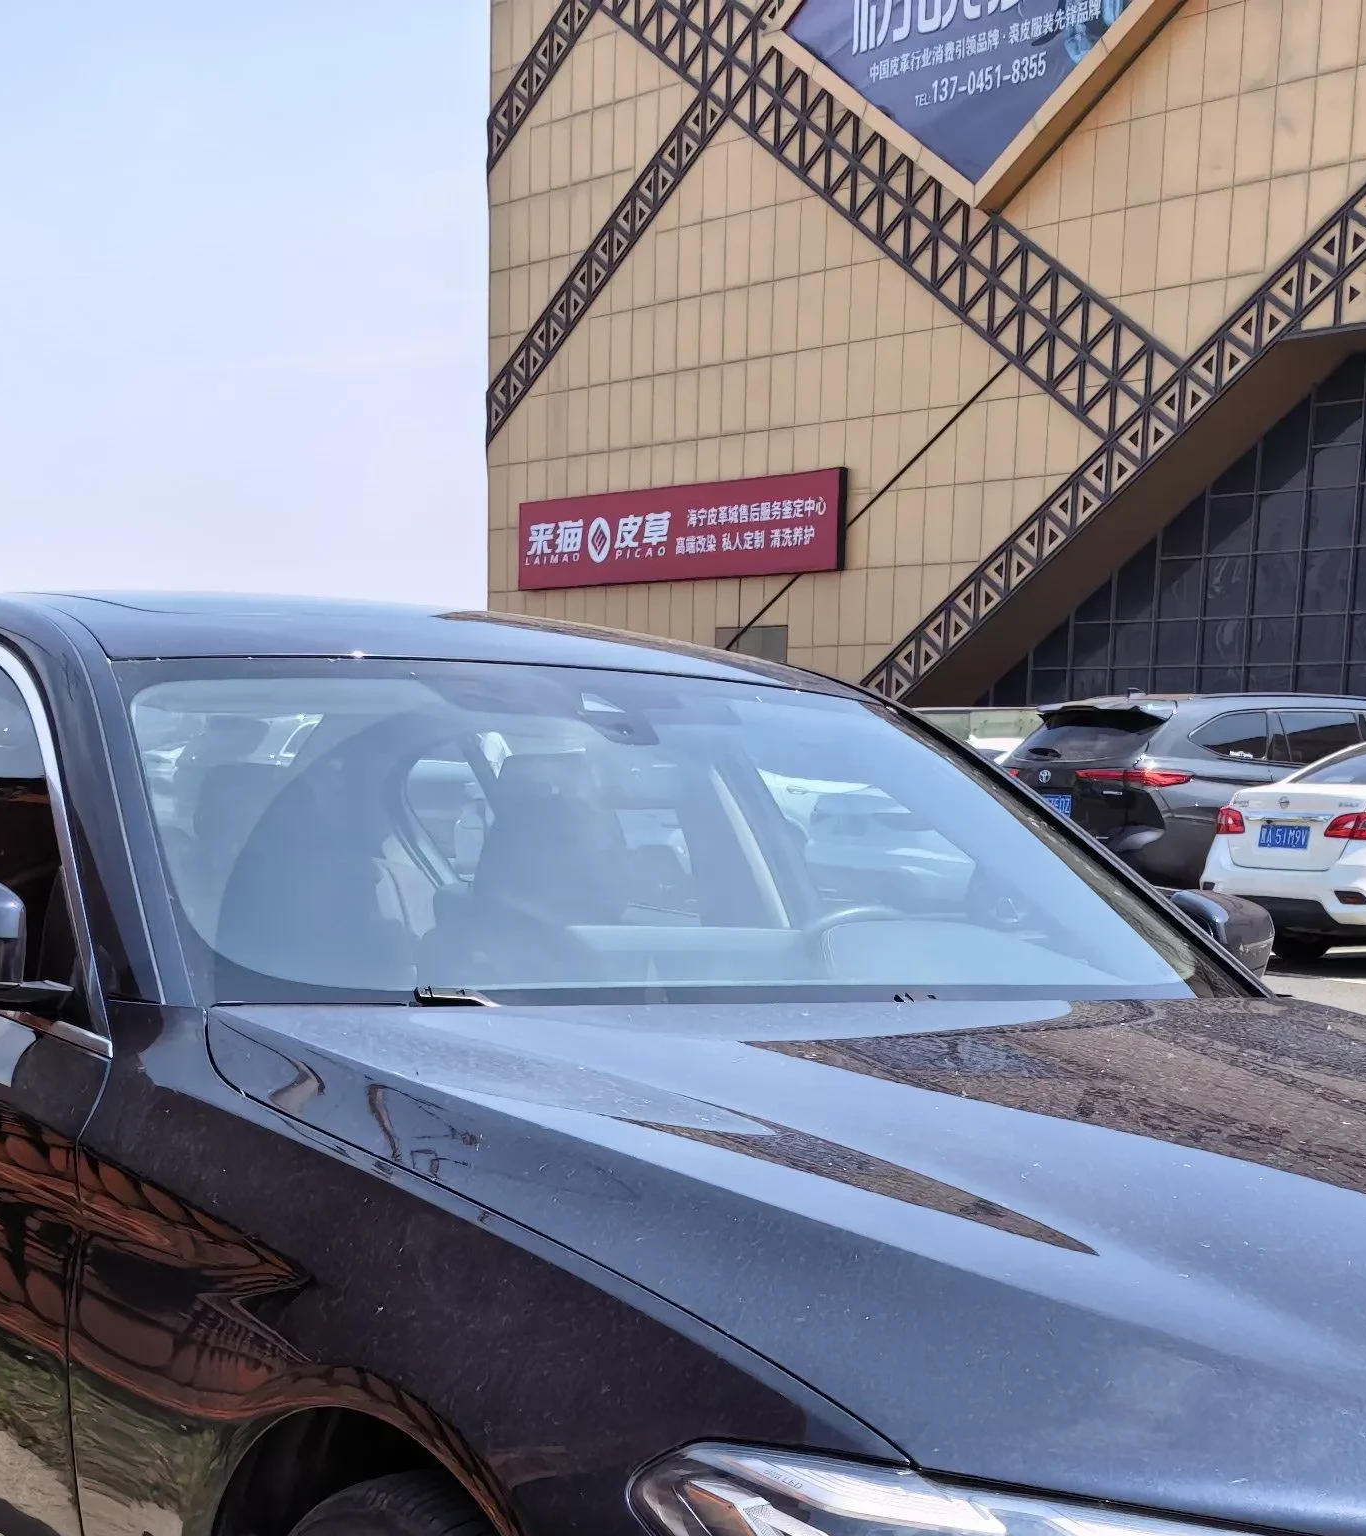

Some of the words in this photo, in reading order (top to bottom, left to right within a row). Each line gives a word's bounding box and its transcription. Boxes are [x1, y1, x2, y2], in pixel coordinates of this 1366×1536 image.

[687, 496, 827, 527] 海宁皮革城售后服务鉴定中心
[527, 519, 584, 555] 来猫
[614, 511, 672, 549] 皮草
[722, 530, 765, 551] 私人定制
[770, 525, 815, 548] 清洗养护
[525, 553, 580, 566] LAIMAO
[615, 546, 667, 561] PICAO
